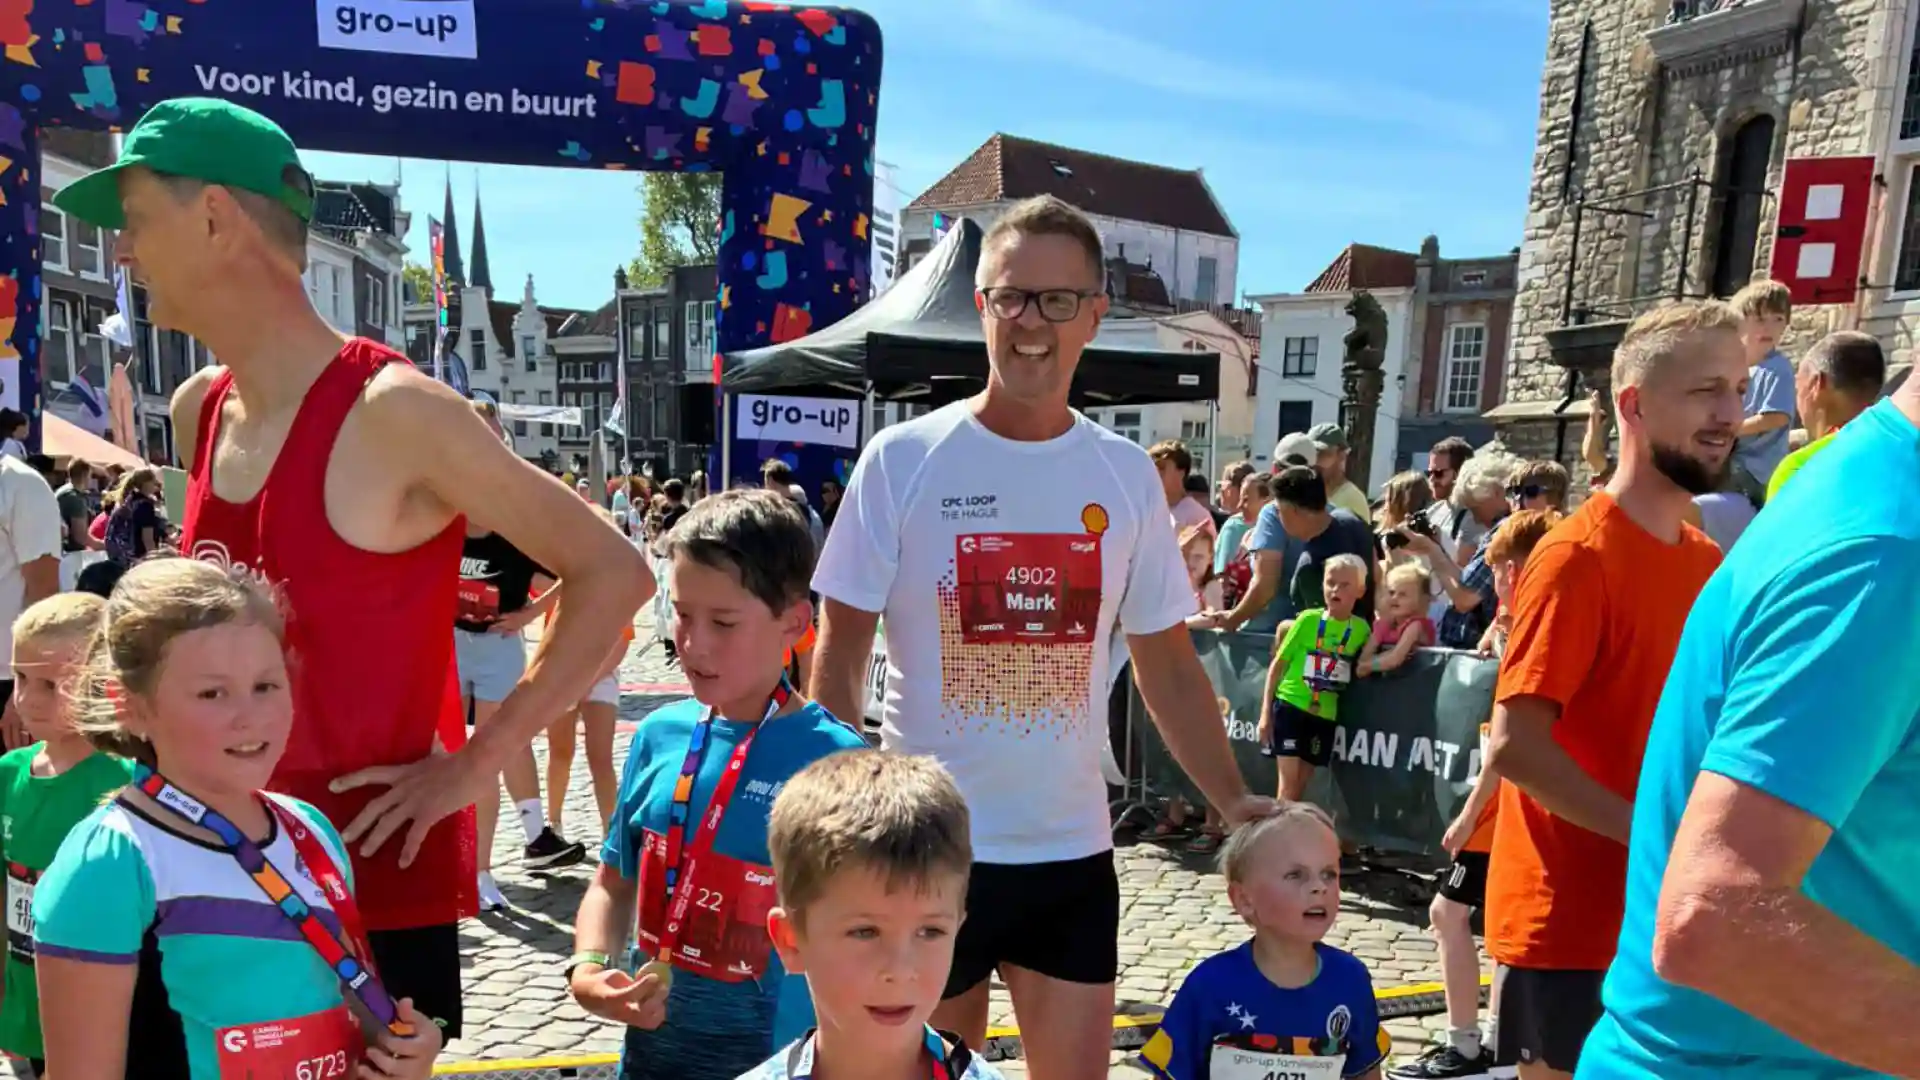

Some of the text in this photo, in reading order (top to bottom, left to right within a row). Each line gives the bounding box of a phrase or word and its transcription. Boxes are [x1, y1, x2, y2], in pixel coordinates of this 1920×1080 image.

[336, 6, 457, 42] gro-up
[194, 64, 597, 117] Voor kind, gezin en buurt
[752, 400, 850, 433] gro-up
[940, 507, 999, 520] THE HAGUE
[941, 495, 997, 508] CPC LOOP
[1005, 566, 1056, 586] 4902
[1005, 591, 1056, 612] Mark
[1448, 861, 1467, 889] 10
[296, 1049, 347, 1080] 6723
